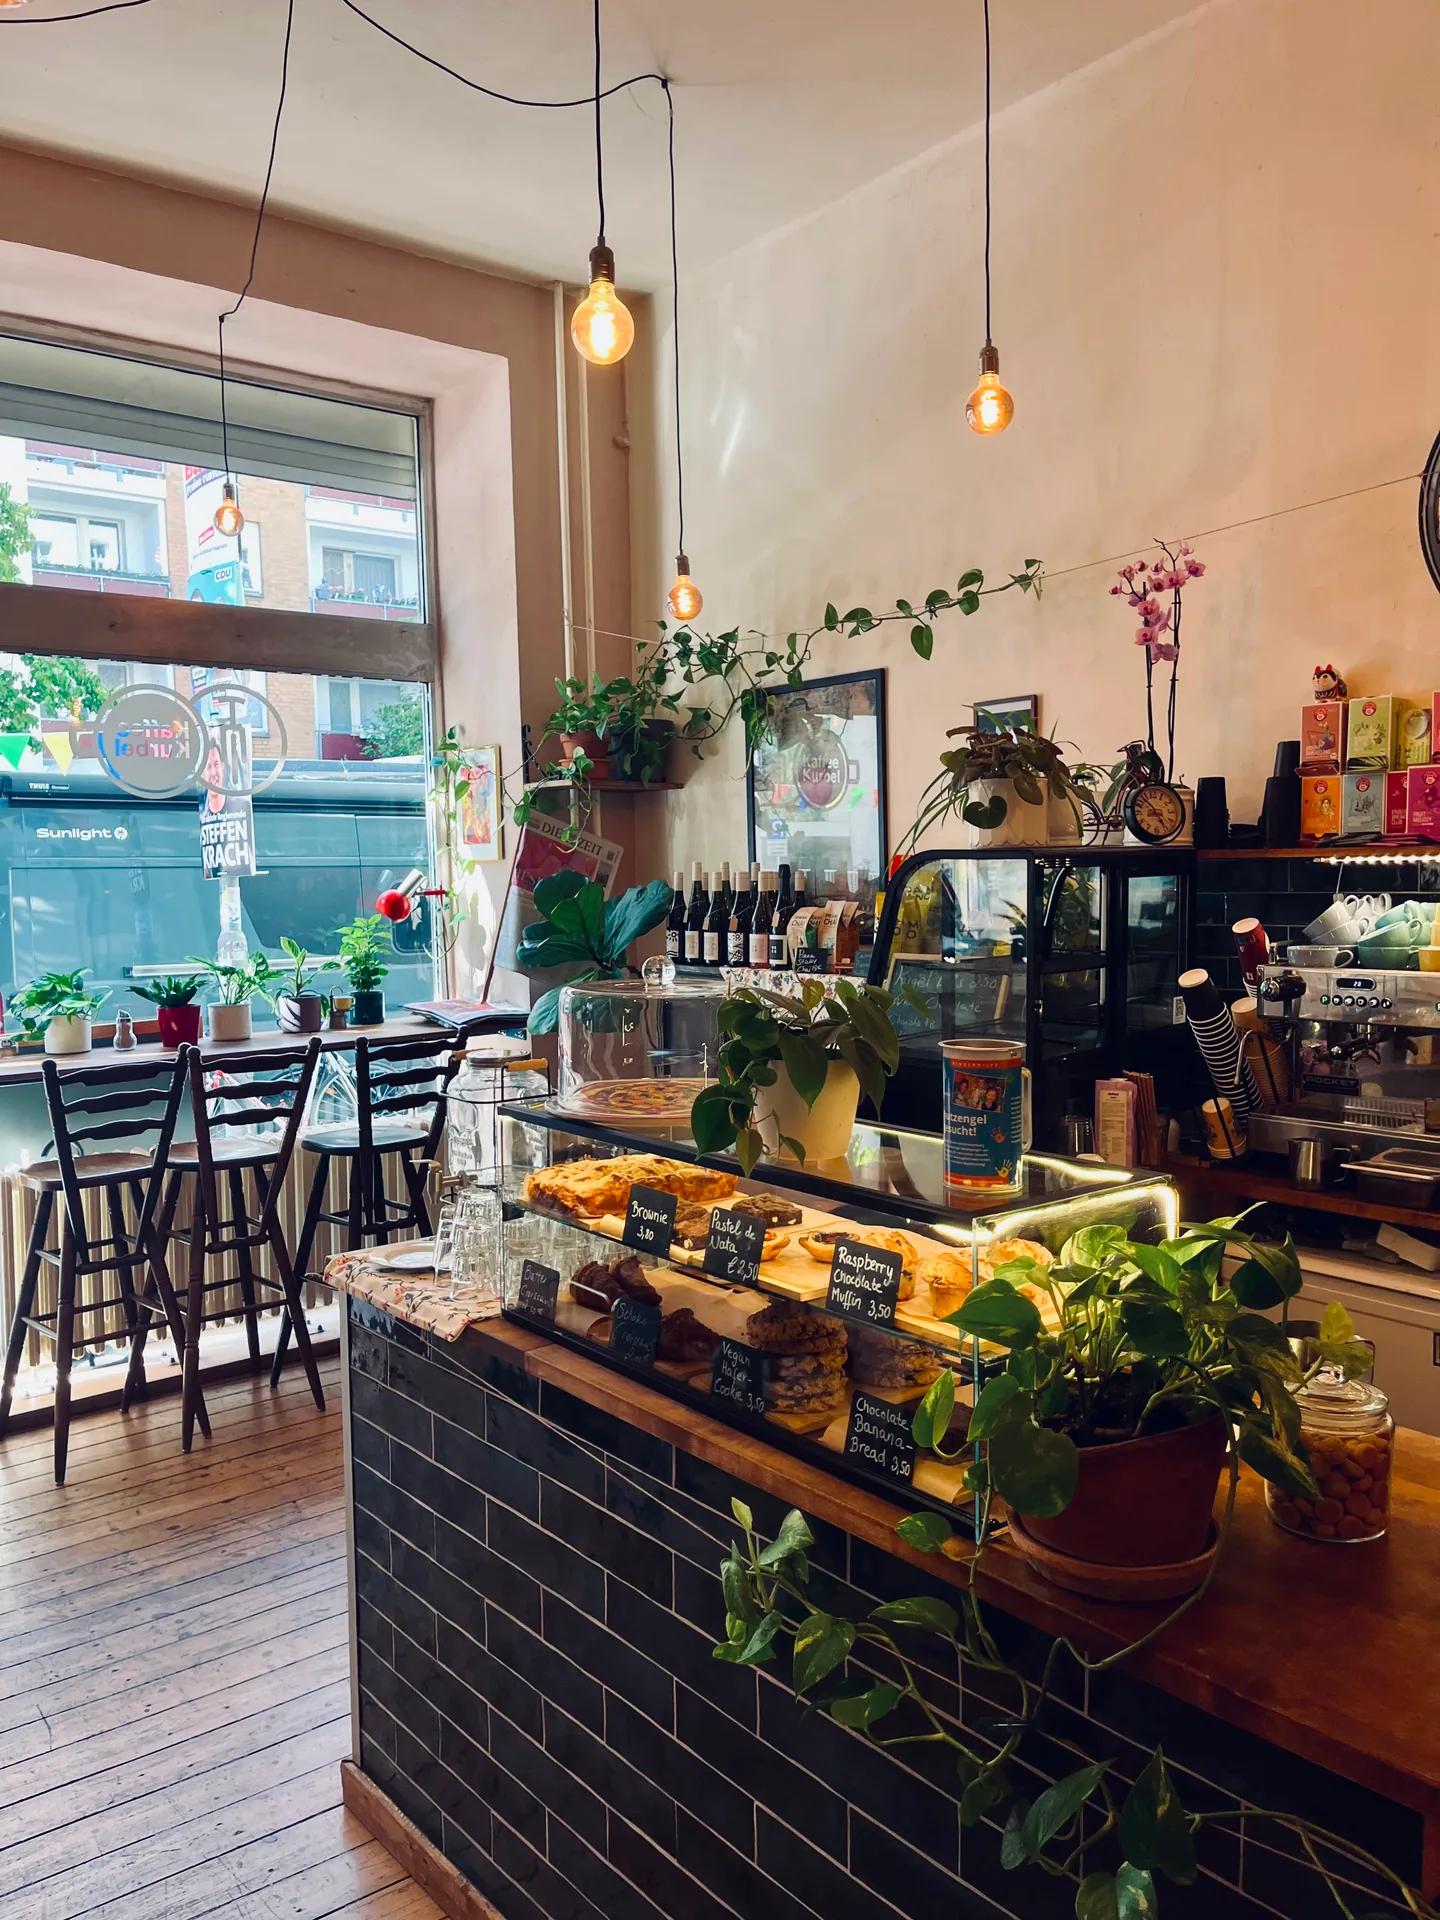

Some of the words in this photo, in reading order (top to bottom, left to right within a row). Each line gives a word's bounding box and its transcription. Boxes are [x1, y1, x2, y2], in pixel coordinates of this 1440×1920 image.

[215, 569, 231, 580] CDU
[29, 782, 50, 790] THULE
[802, 768, 841, 783] Kurbel
[36, 827, 112, 841] Sunlight
[201, 819, 248, 846] STEFFEN
[541, 821, 563, 839] DIE
[576, 837, 604, 857] ZEIT
[202, 841, 250, 869] KRACH
[1306, 1075, 1356, 1087] ROCKET
[631, 1200, 668, 1225] Brownie
[711, 1209, 742, 1236] Pastel
[745, 1224, 756, 1240] de
[636, 1225, 654, 1241] 3,80
[708, 1235, 738, 1254] Nata
[838, 1246, 896, 1287] Raspberry
[833, 1268, 883, 1294] Chocolate
[831, 1286, 862, 1311] Muffin
[867, 1299, 891, 1320] 3,50
[722, 1340, 751, 1368] Vegan
[722, 1359, 753, 1386] Hafer-
[714, 1377, 743, 1402] Cookie
[746, 1392, 765, 1413] 3,50
[854, 1413, 914, 1450] Banana-
[849, 1436, 886, 1467] Bread
[891, 1455, 911, 1476] 3,50
